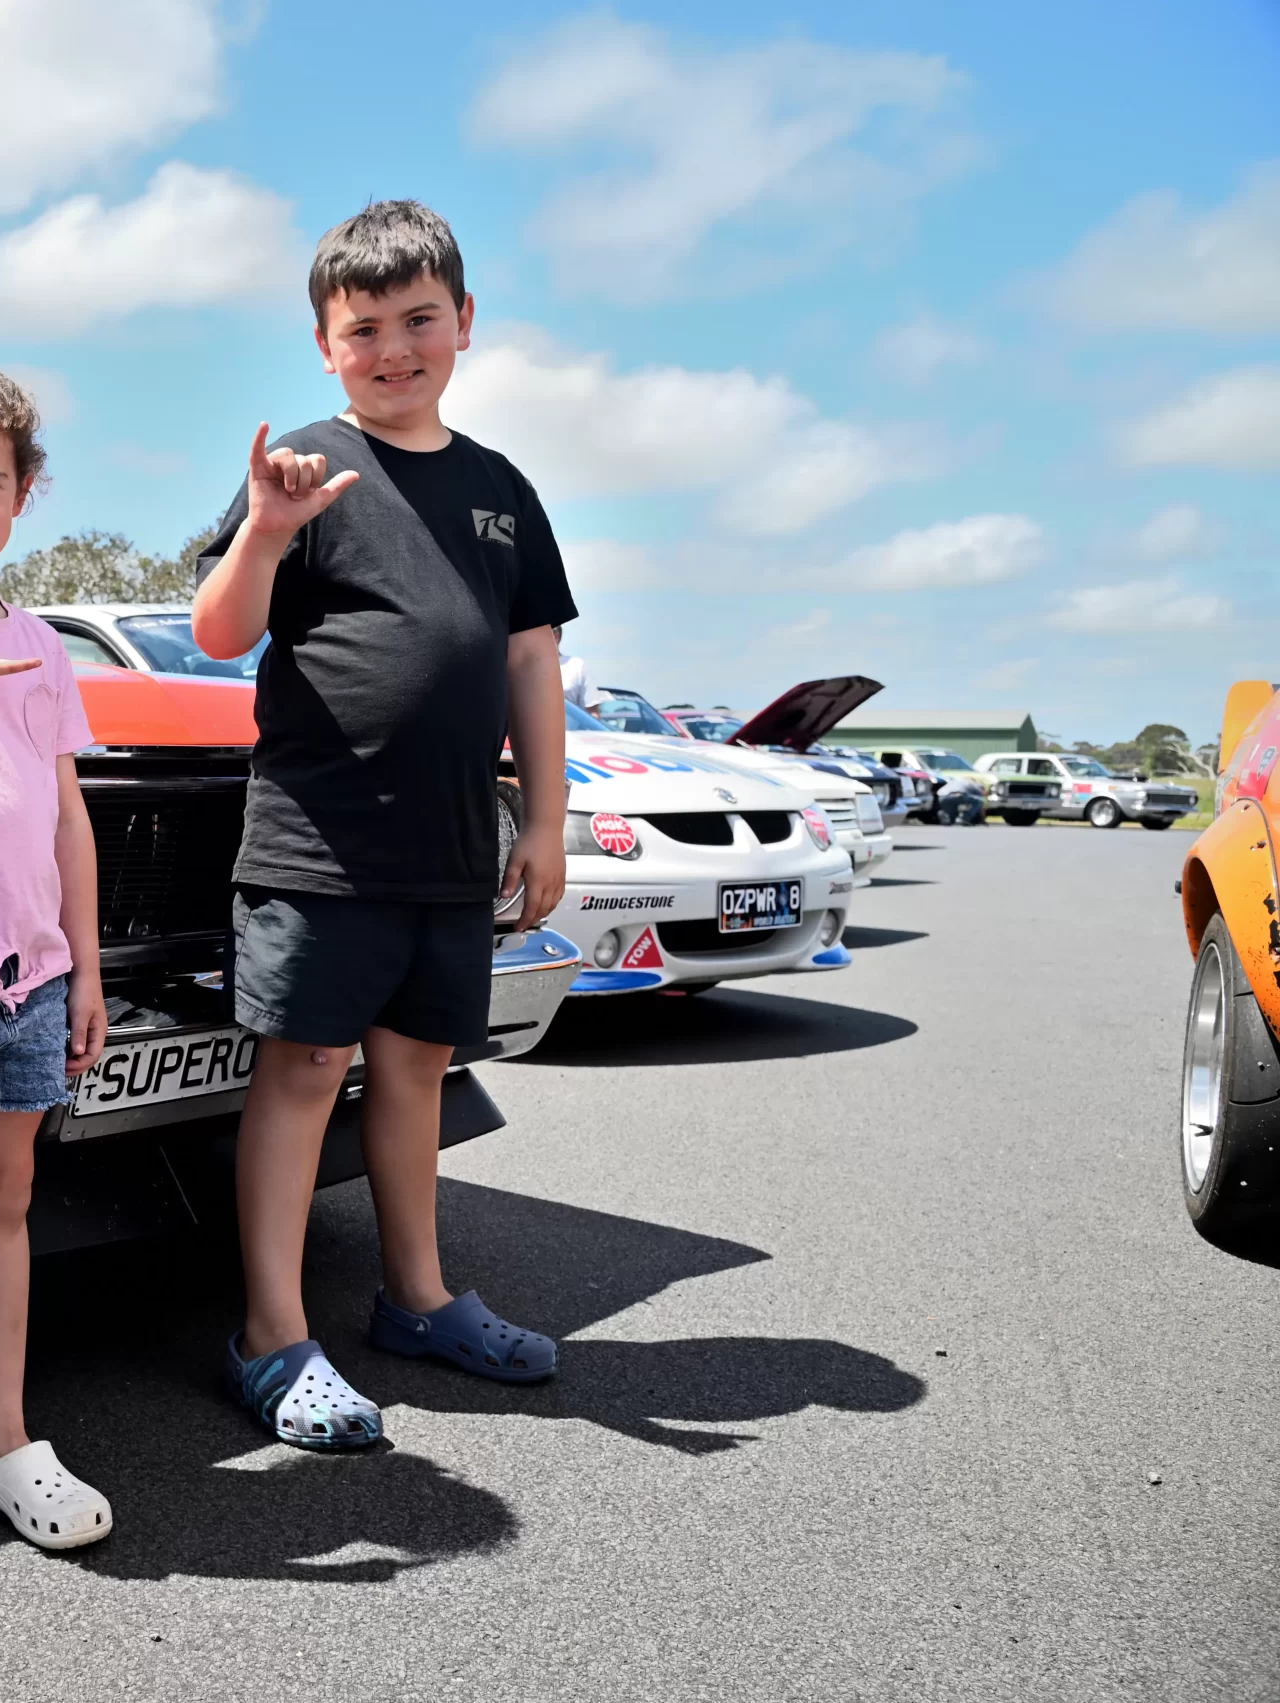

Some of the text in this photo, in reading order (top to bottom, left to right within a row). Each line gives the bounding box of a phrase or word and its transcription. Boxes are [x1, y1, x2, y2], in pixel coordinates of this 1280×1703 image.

[580, 896, 676, 911] BRIDGESTONE
[722, 887, 777, 914] OZPWR
[789, 885, 800, 909] 8
[627, 936, 653, 966] TOW
[98, 1033, 260, 1102] SUPERO
